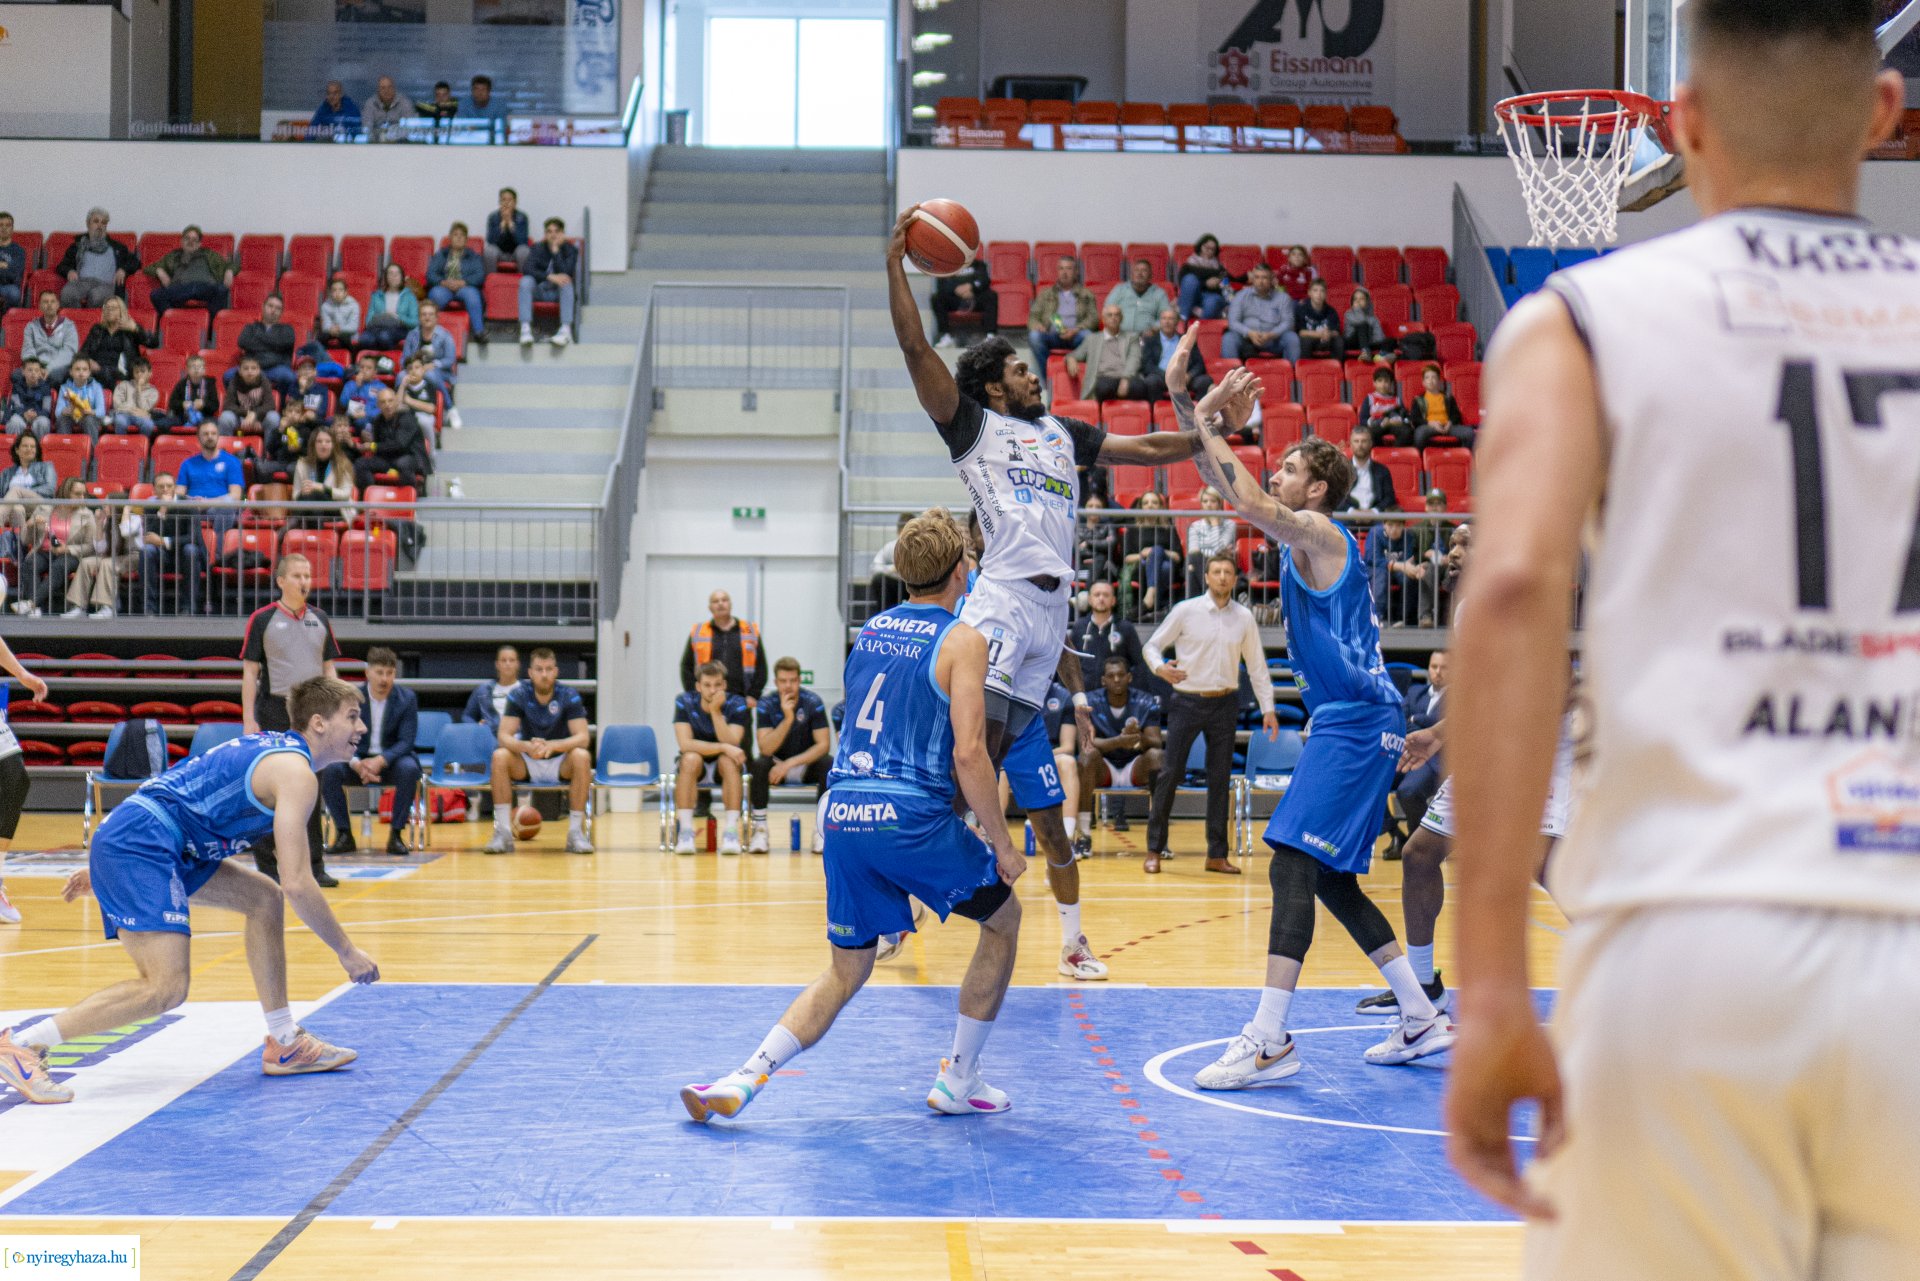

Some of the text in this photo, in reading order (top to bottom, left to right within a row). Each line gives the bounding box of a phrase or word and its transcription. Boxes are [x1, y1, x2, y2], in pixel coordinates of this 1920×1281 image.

[1270, 49, 1373, 75] Eissmann
[129, 119, 205, 135] Continental
[867, 614, 938, 637] KOMETA
[856, 672, 886, 745] 4
[1038, 763, 1058, 788] 13
[827, 801, 899, 823] KOMETA
